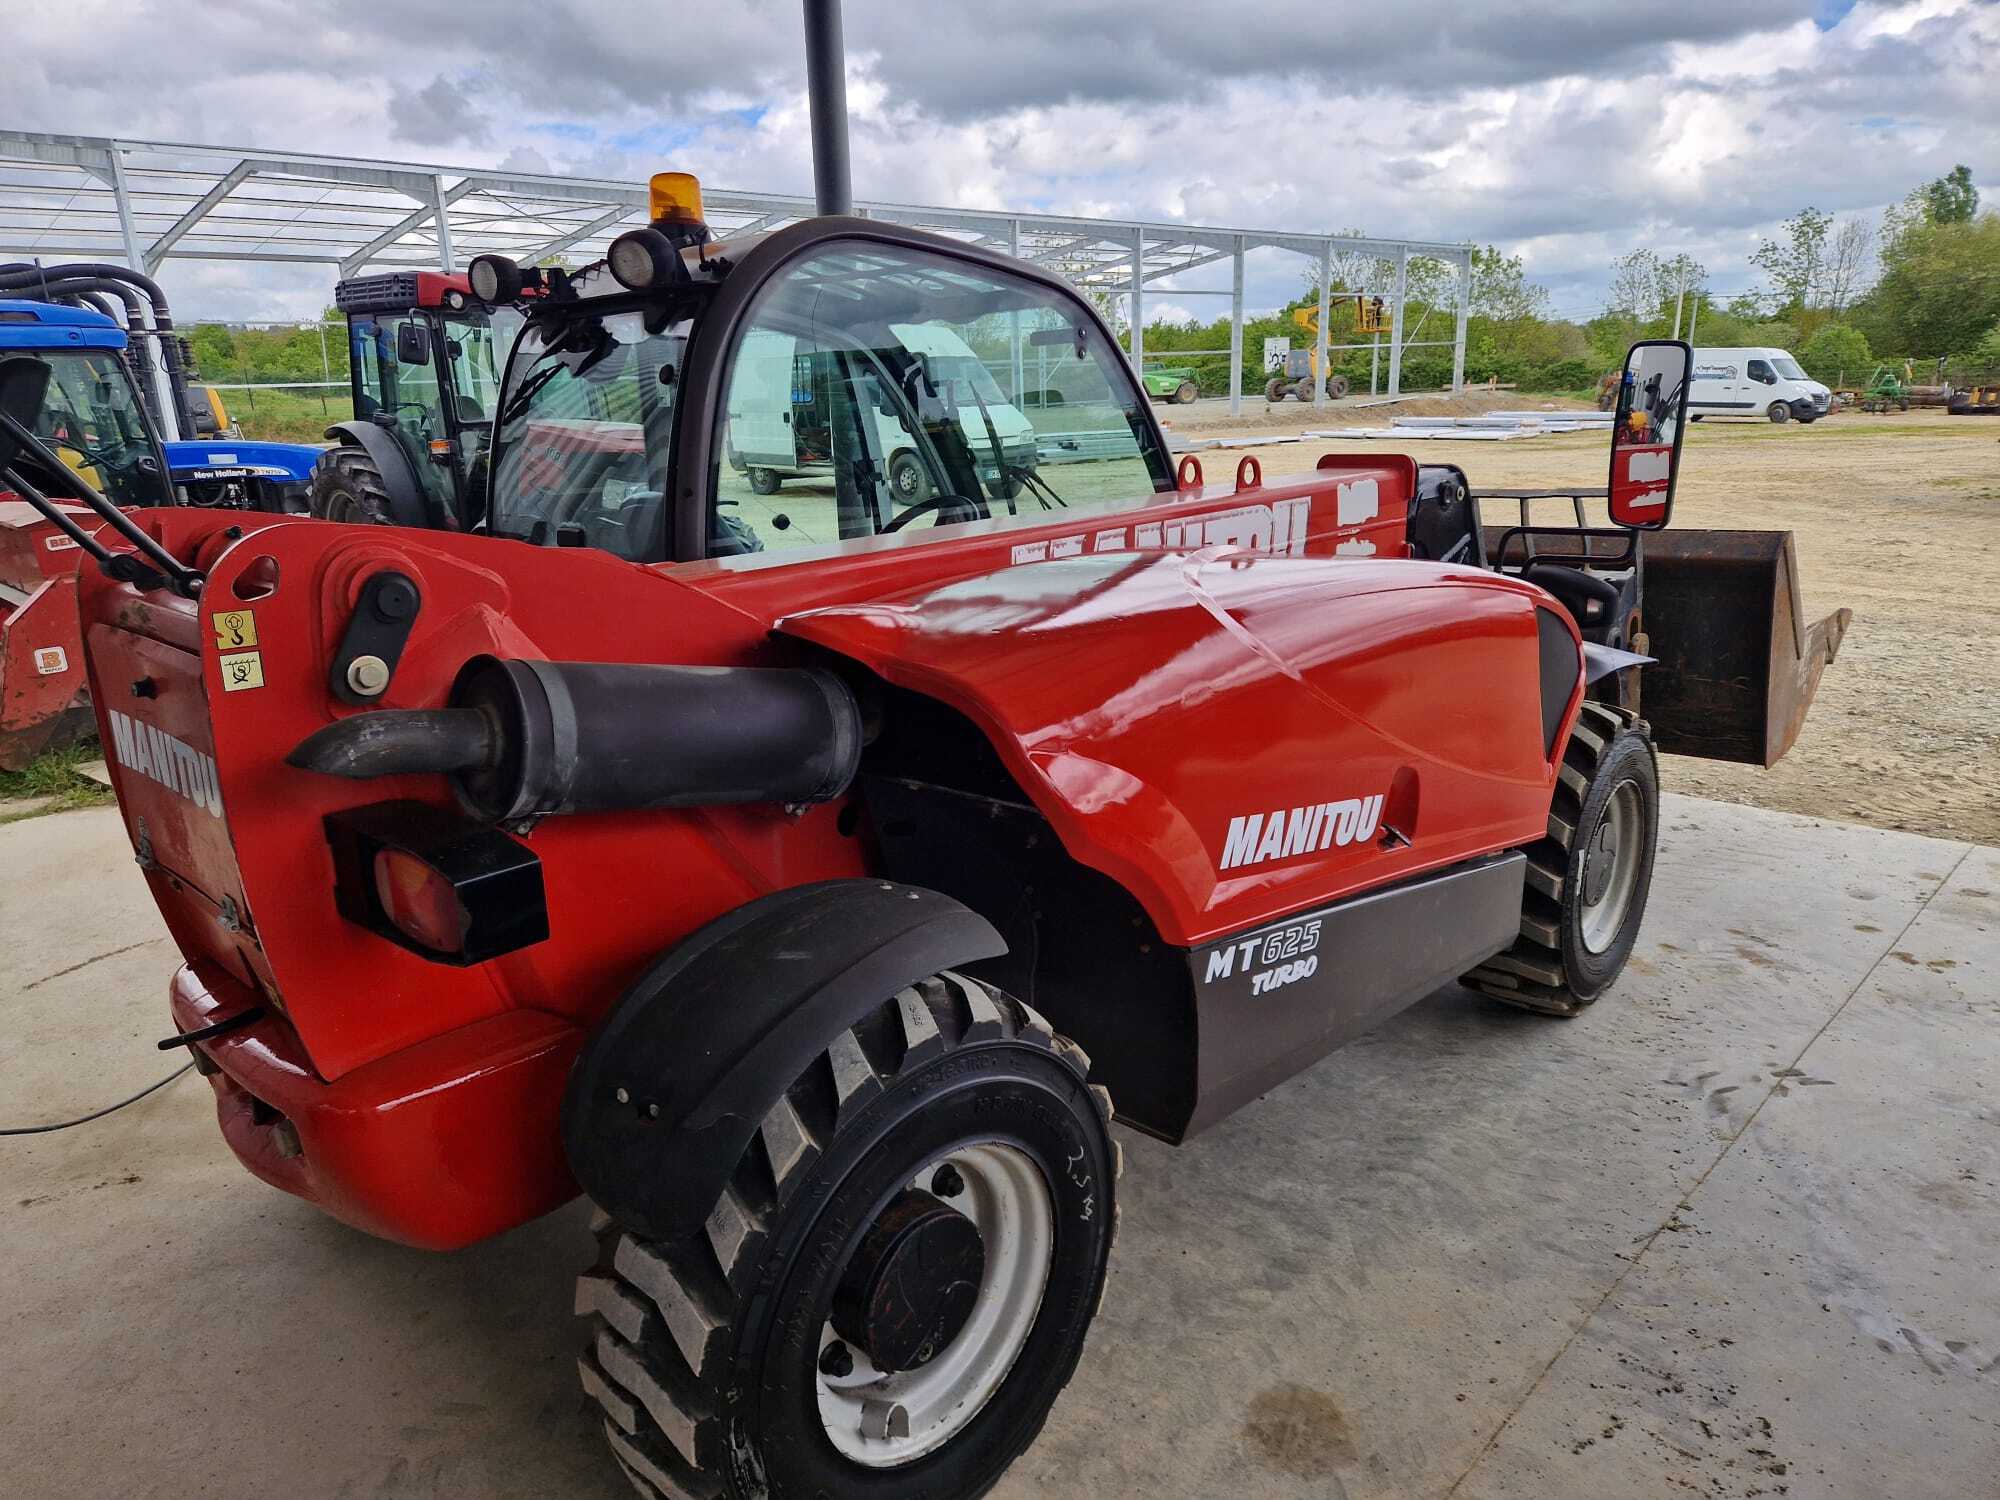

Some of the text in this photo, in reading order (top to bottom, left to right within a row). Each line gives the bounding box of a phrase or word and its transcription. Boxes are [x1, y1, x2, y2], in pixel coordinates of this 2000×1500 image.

[194, 469, 246, 479] New Holland
[109, 709, 221, 818] MANITOU
[1219, 794, 1384, 870] MANITOU
[1252, 955, 1319, 996] TURBO
